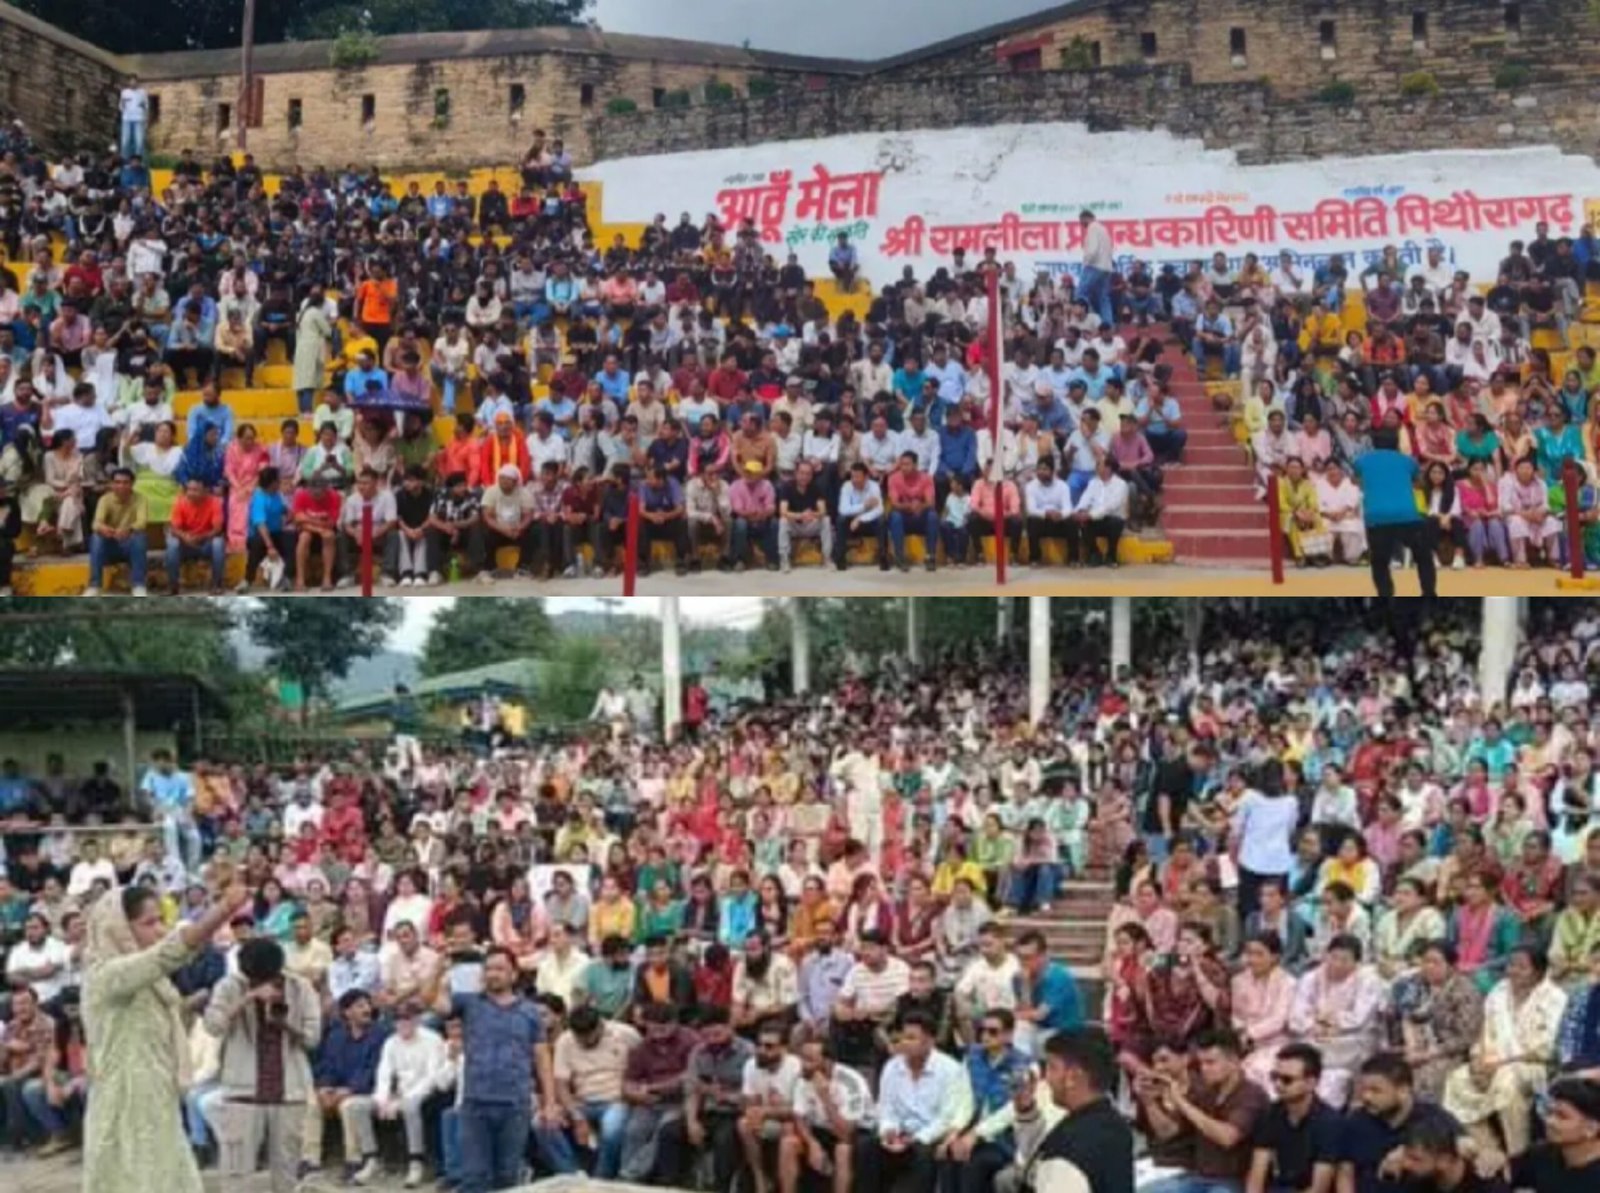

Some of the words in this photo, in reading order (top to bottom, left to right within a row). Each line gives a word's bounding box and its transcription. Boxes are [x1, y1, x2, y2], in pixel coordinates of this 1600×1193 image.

[796, 163, 883, 221] मेला
[880, 214, 925, 257] श्री
[929, 211, 1062, 254] रामलीला
[1065, 204, 1277, 251] प्रन्धकारिणी
[1281, 196, 1388, 241] समिति
